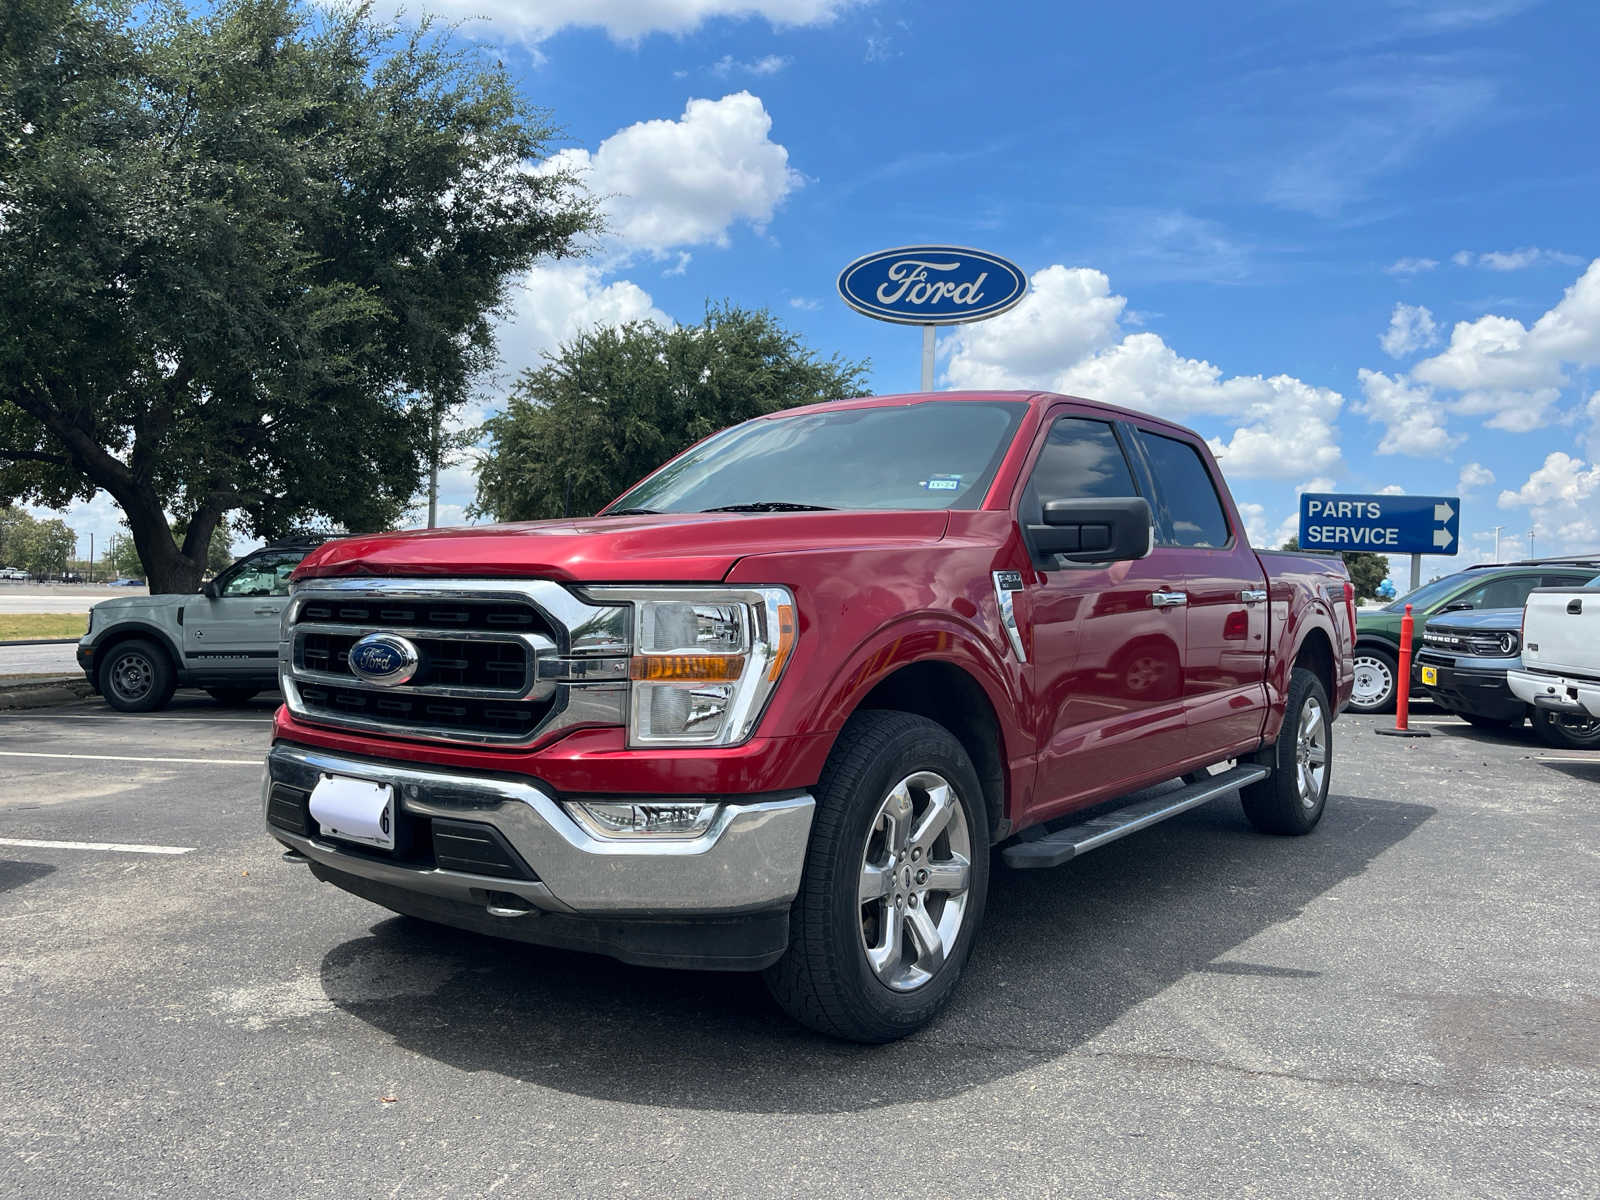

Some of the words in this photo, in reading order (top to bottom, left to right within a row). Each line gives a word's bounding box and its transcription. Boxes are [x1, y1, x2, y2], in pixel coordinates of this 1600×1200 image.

[876, 260, 988, 305] Ford
[1308, 500, 1381, 519] PARTS
[1308, 525, 1399, 545] SERVICE
[360, 647, 392, 671] Ford
